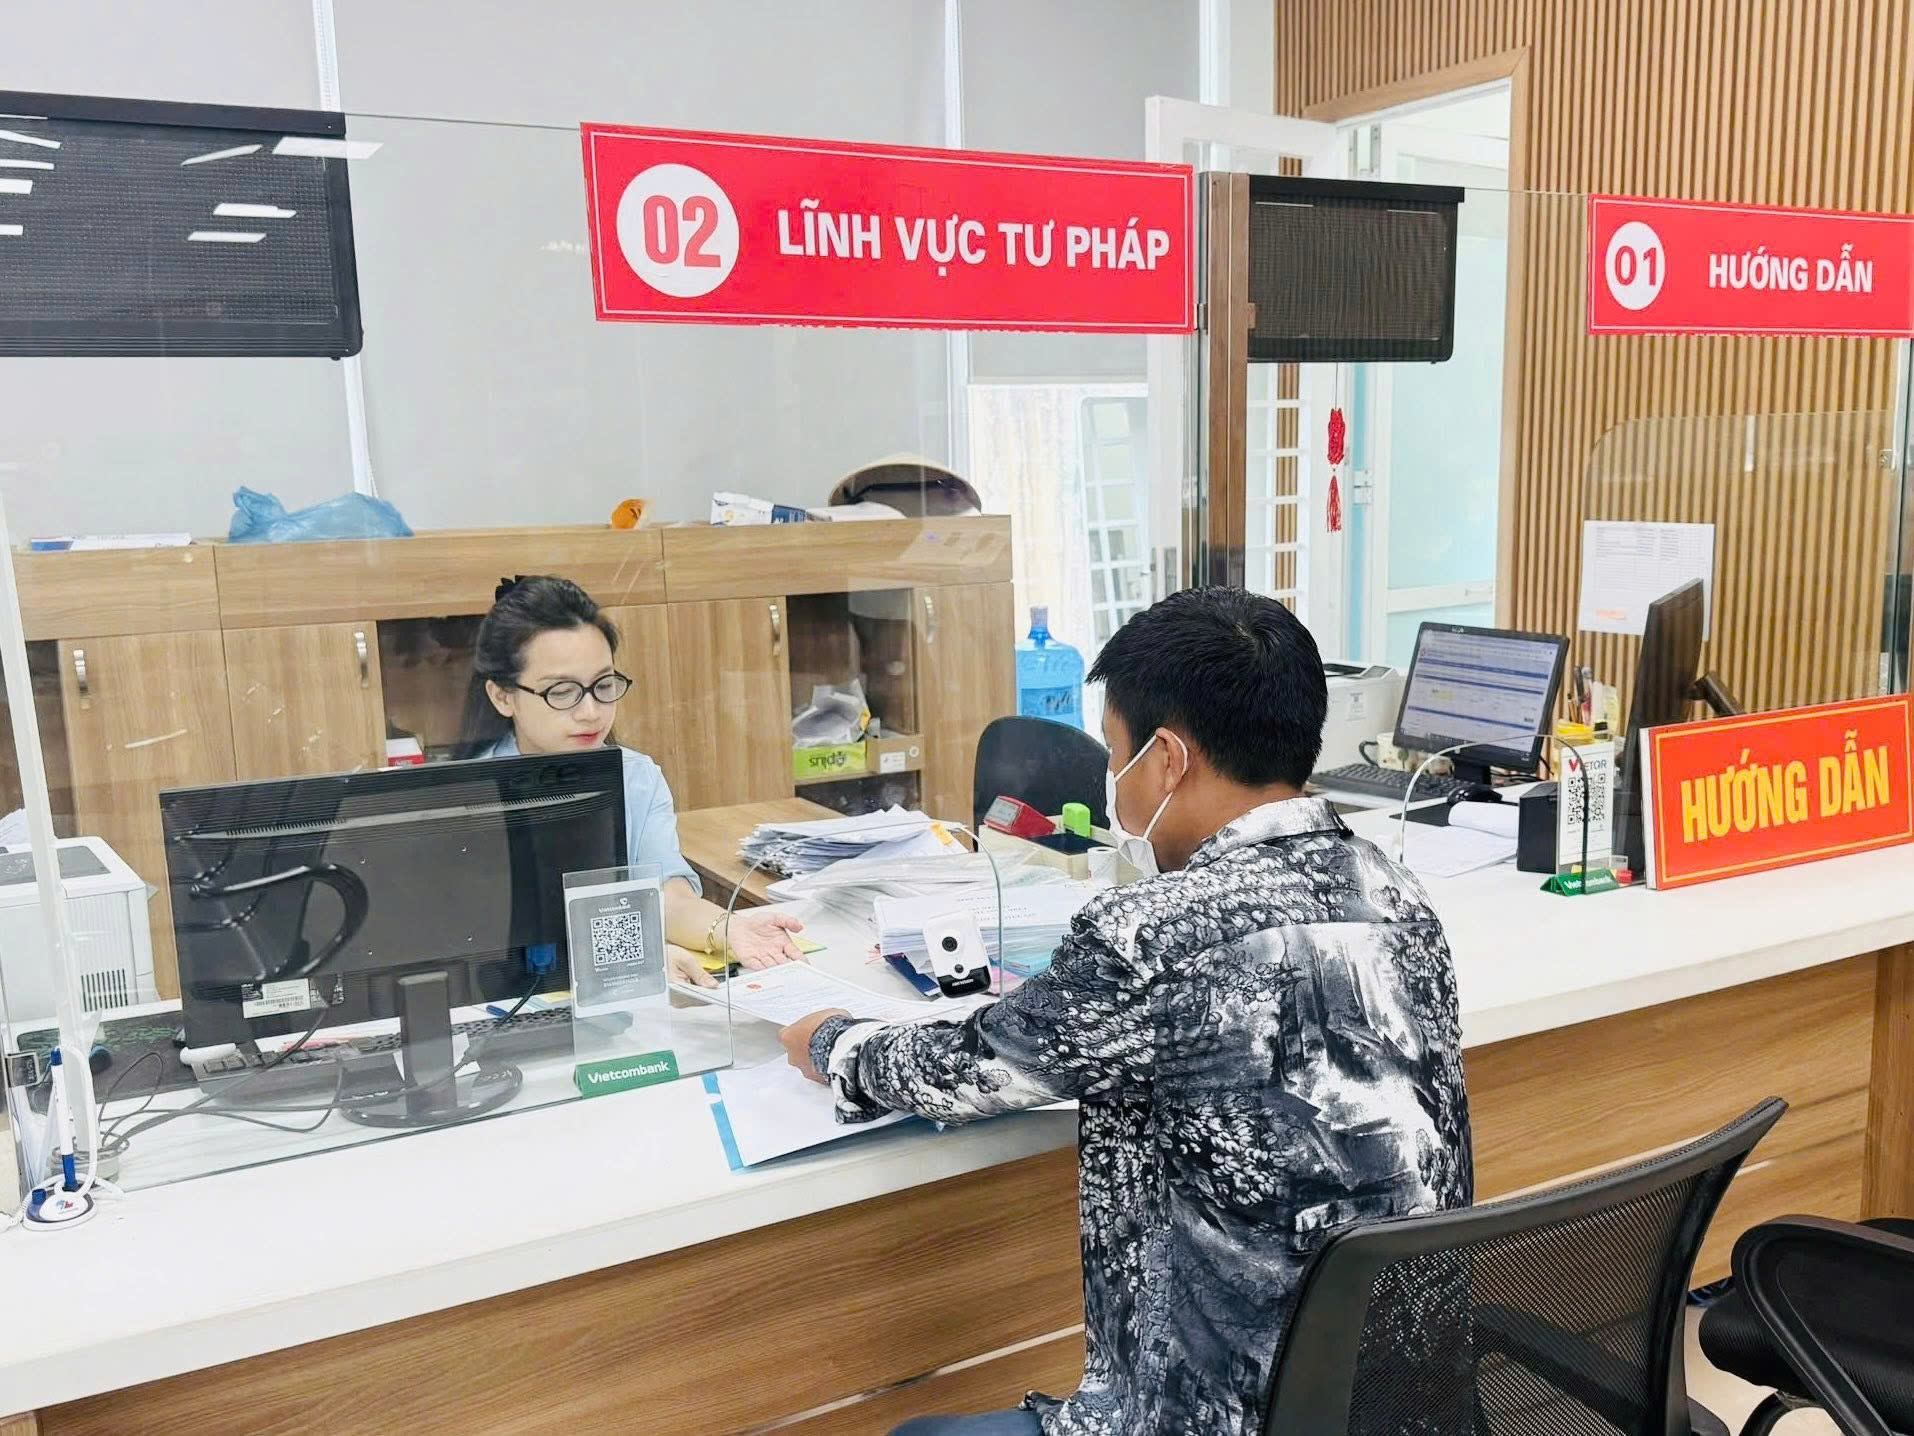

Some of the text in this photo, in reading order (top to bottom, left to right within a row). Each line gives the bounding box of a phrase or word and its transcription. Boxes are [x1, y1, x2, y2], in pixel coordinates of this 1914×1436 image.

[643, 194, 1170, 277] 02 LĨNH VỰC TƯ PHÁP
[1614, 243, 1873, 293] 01 HƯỚNG DẪN
[1568, 758, 1607, 772] VETQR
[1680, 729, 1891, 844] HƯỚNG DẪN
[588, 1060, 670, 1084] Vietcombank
